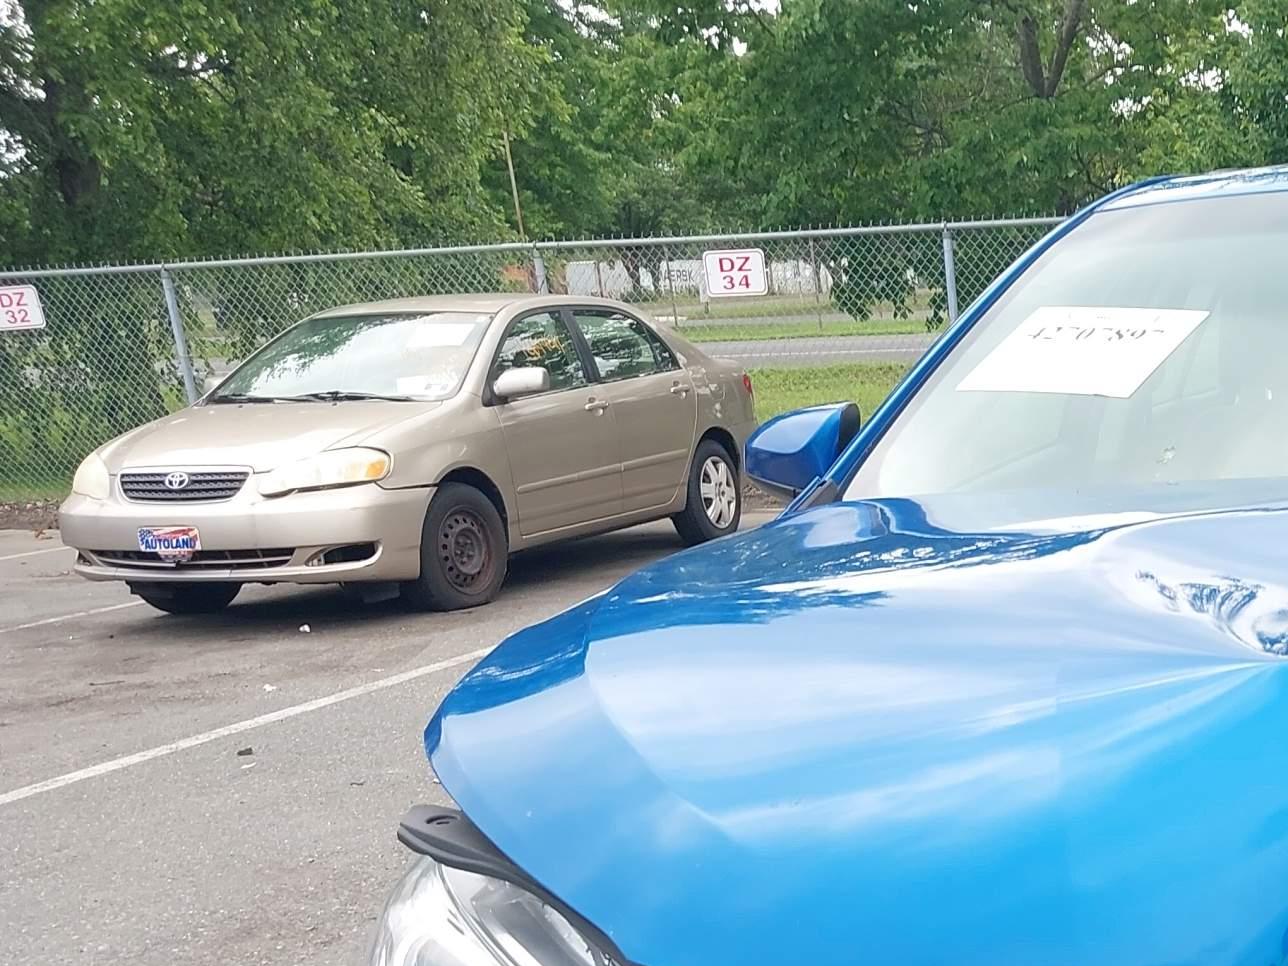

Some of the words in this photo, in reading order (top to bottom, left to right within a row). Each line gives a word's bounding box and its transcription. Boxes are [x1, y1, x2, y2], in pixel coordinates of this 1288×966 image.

[719, 256, 752, 272] DZ
[722, 274, 751, 289] 34
[0, 292, 27, 307] DZ
[5, 309, 31, 324] 32
[144, 536, 197, 550] AUTOLAND
